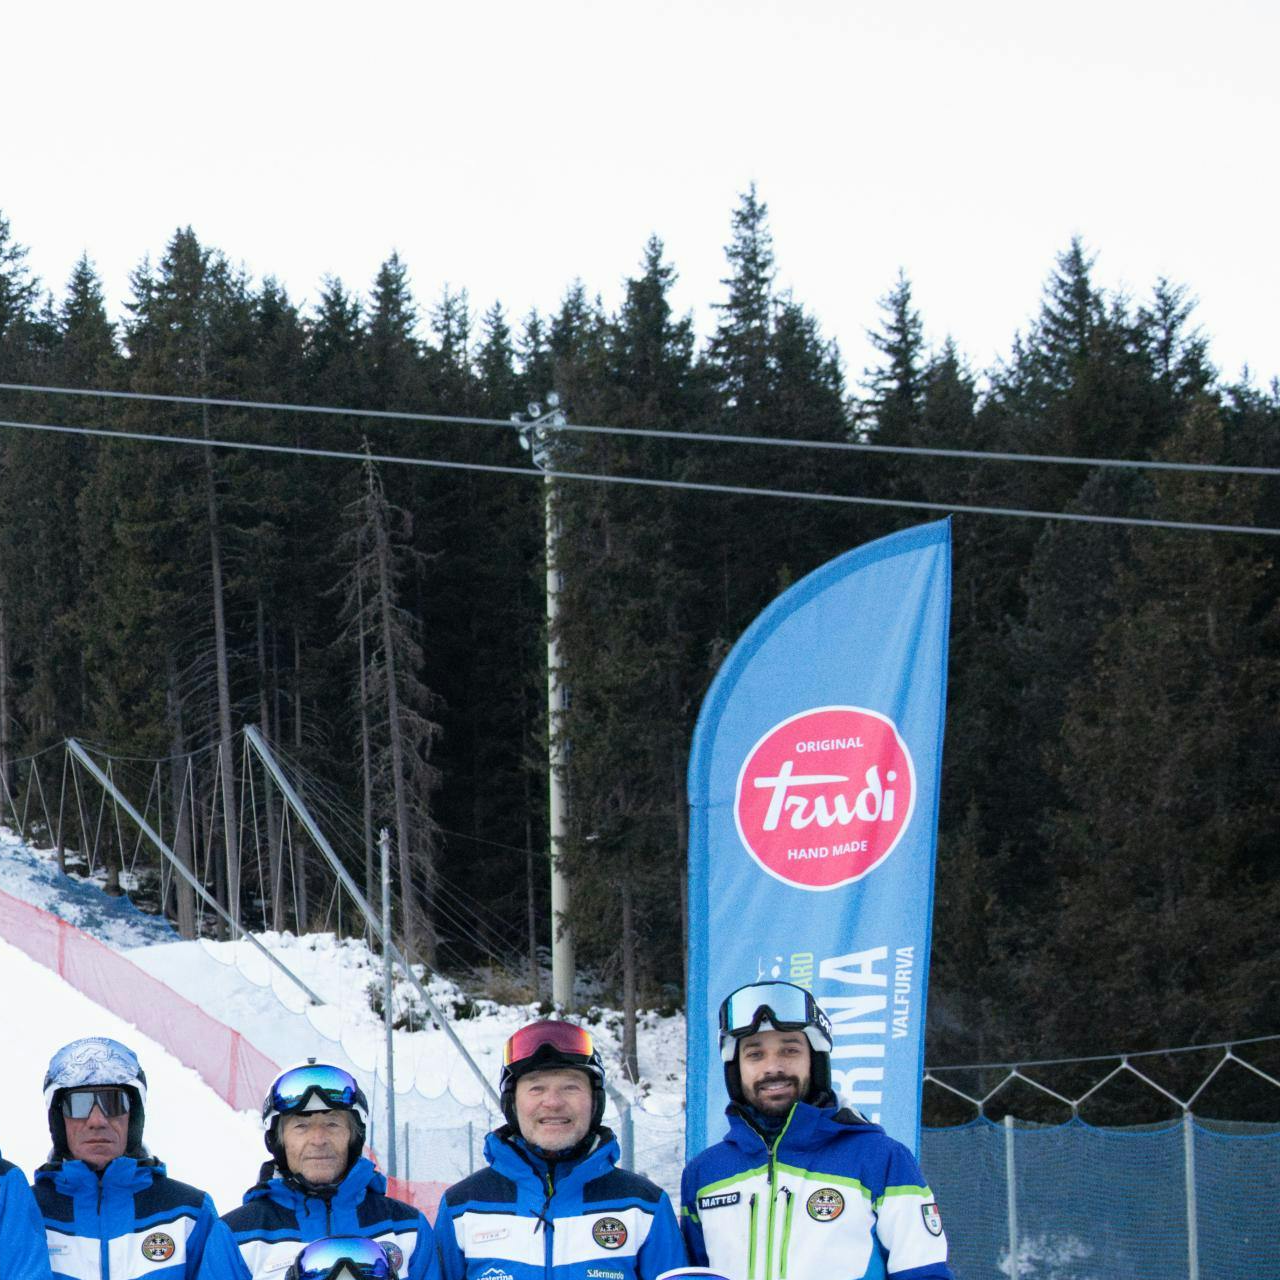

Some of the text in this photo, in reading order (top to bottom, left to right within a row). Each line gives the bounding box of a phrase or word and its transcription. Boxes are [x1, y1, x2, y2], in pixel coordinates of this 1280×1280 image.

[795, 736, 865, 753] ORIGINAL
[753, 760, 897, 831] Trudi
[787, 840, 869, 860] HAND MADE
[892, 946, 914, 1040] VALFURVA
[701, 1194, 738, 1207] MATTEO
[586, 1269, 624, 1280] S.Bernardo
